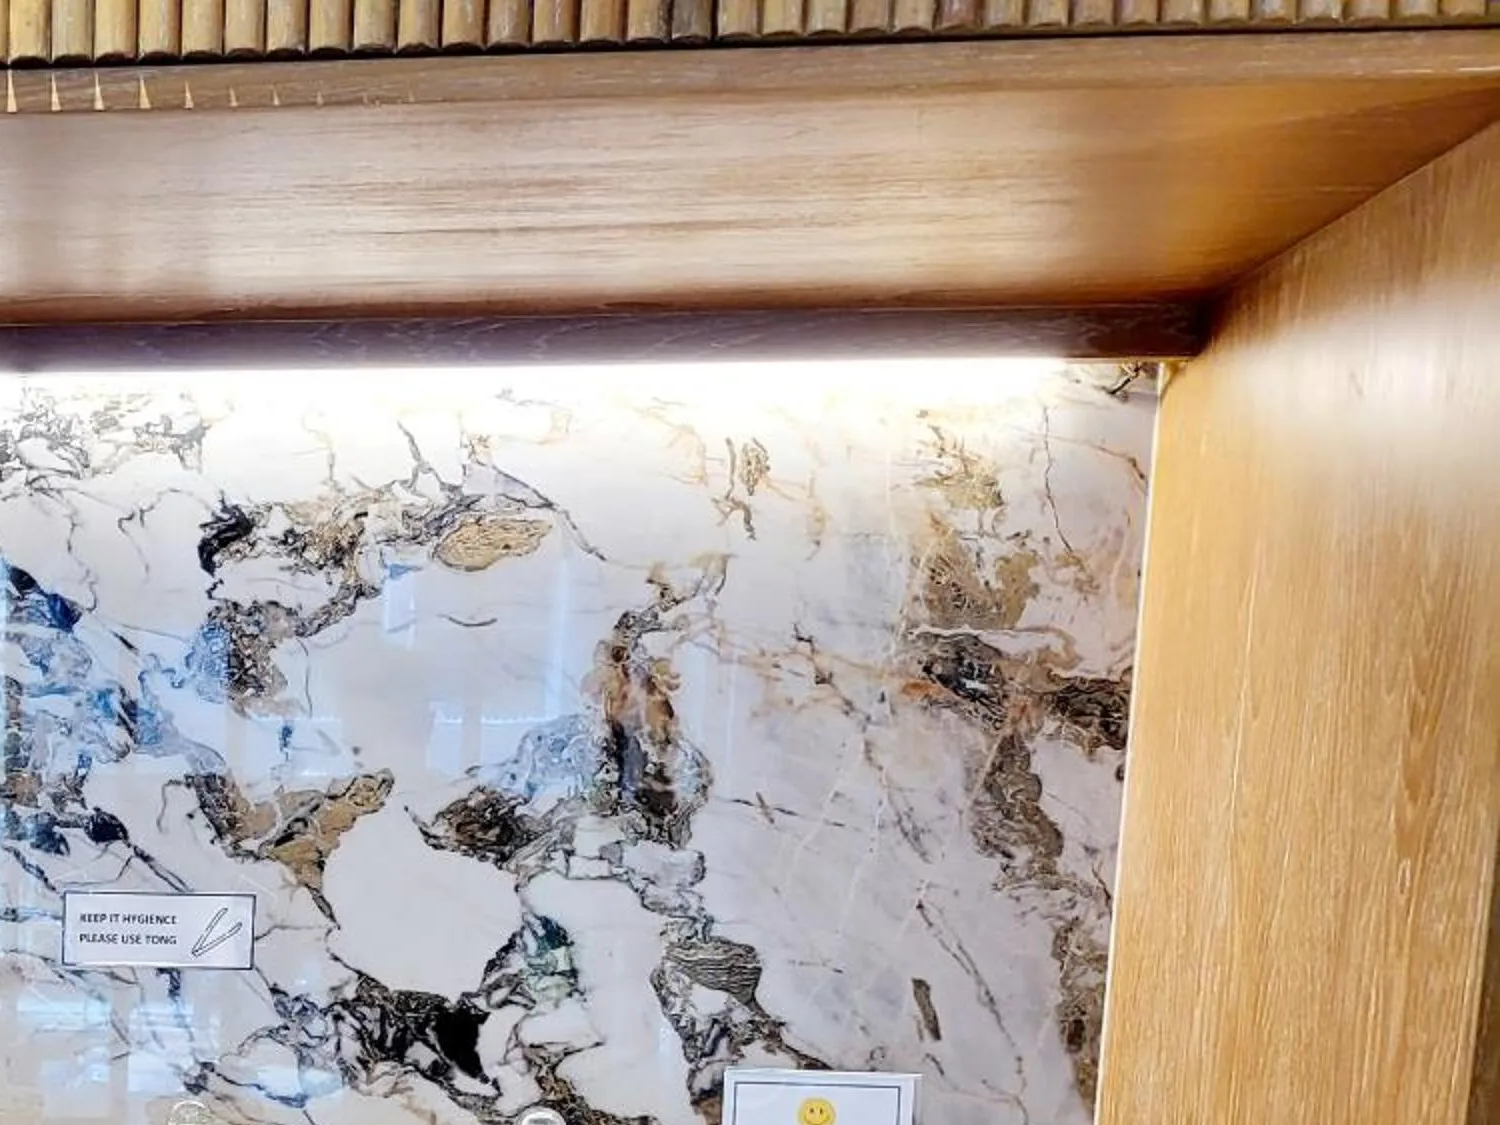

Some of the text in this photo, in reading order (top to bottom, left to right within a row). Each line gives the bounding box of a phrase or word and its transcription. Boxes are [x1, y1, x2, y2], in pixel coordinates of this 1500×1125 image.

[80, 913, 177, 925] KEEP IT HYGIENCE
[79, 933, 177, 945] PLEASE USE TONG
